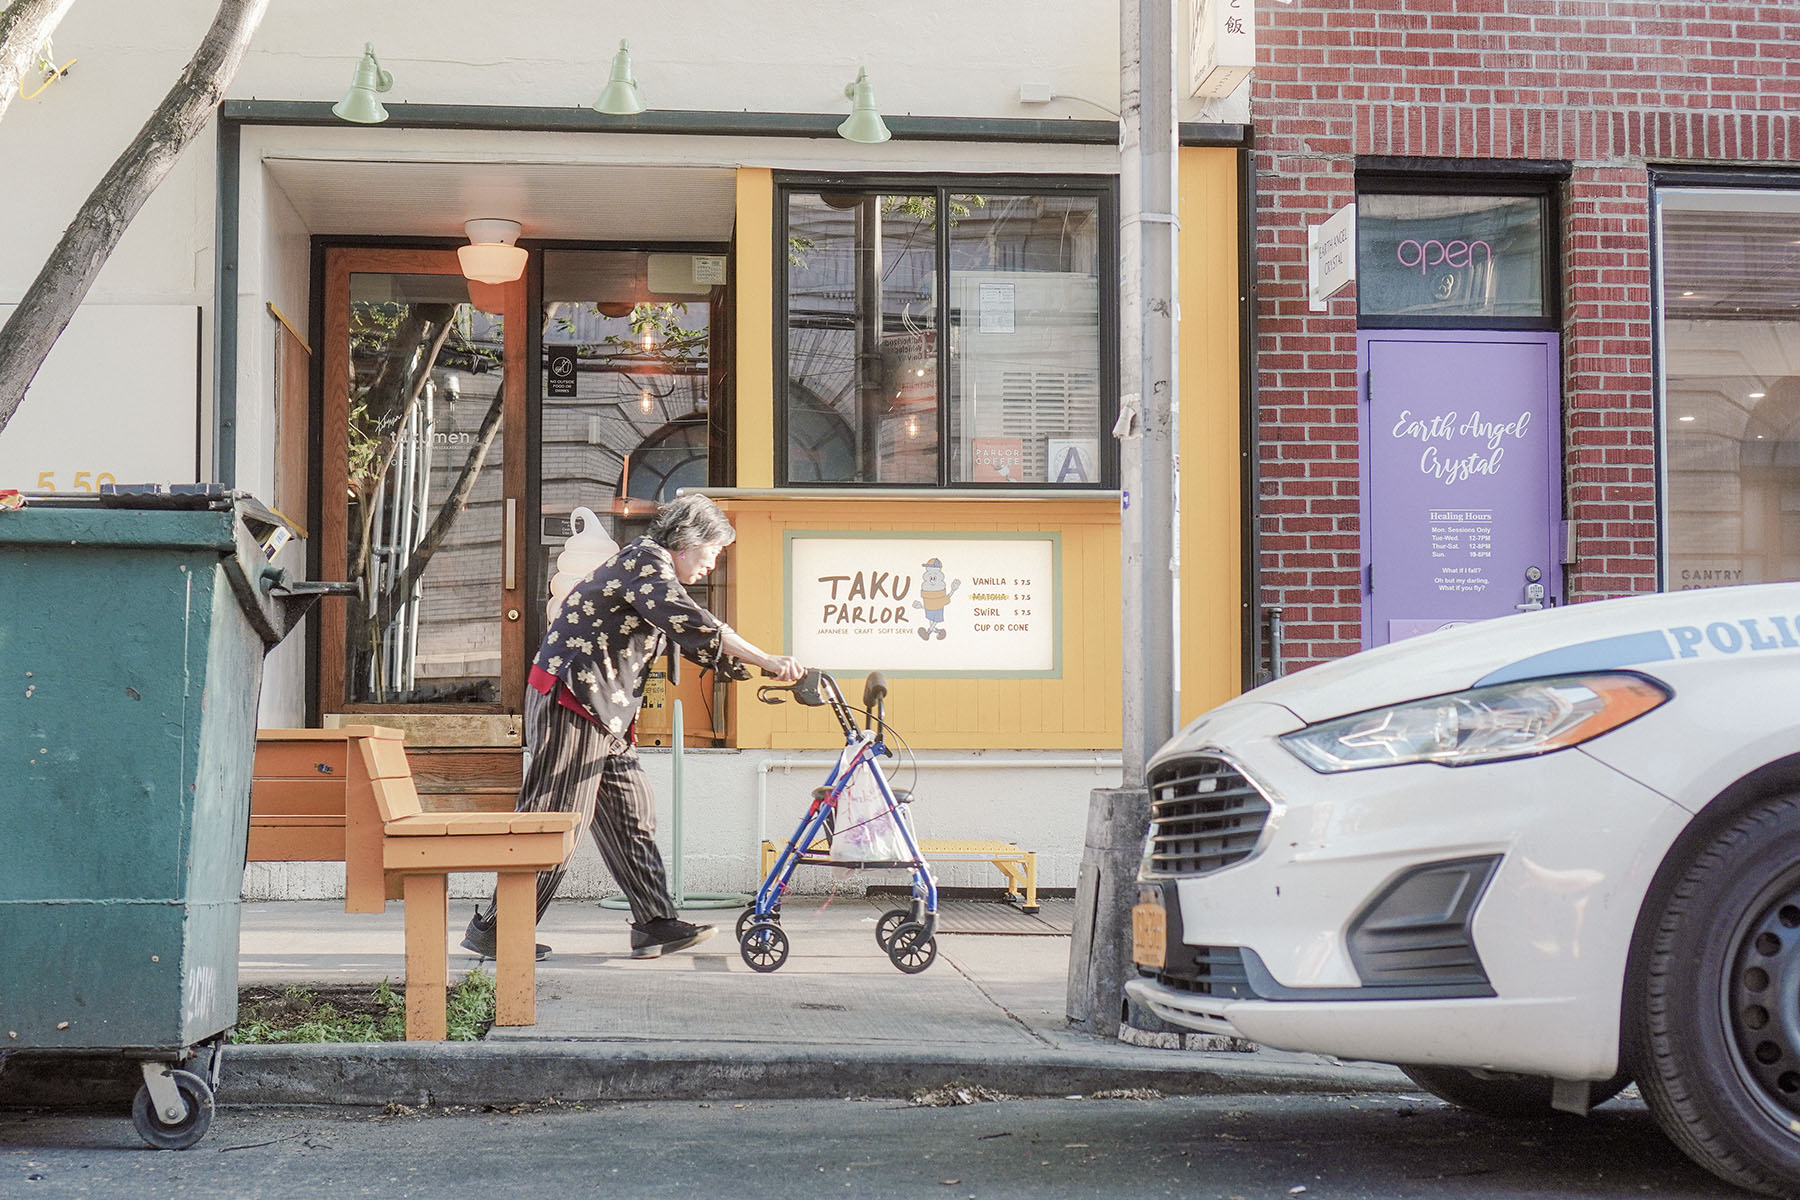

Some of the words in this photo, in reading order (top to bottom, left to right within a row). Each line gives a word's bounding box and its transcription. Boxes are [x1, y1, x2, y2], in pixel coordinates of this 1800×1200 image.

[1397, 239, 1491, 276] open
[1392, 409, 1457, 441] Earth
[1460, 410, 1532, 450] Angel
[975, 449, 1020, 457] PARLOR
[1055, 446, 1089, 483] A
[1420, 446, 1504, 485] Crystal
[1430, 512, 1464, 522] Healing
[1465, 512, 1492, 520] Hours
[1476, 527, 1491, 535] Only
[972, 577, 1006, 586] VANILLA
[1681, 569, 1742, 581] GANTRY
[818, 570, 911, 601] TAKU
[823, 602, 909, 625] PARLOR
[973, 607, 1000, 617] SWIRL
[974, 623, 991, 632] CUP
[993, 623, 1005, 632] OR
[1007, 623, 1029, 632] CONE
[1668, 615, 1800, 659] POLI
